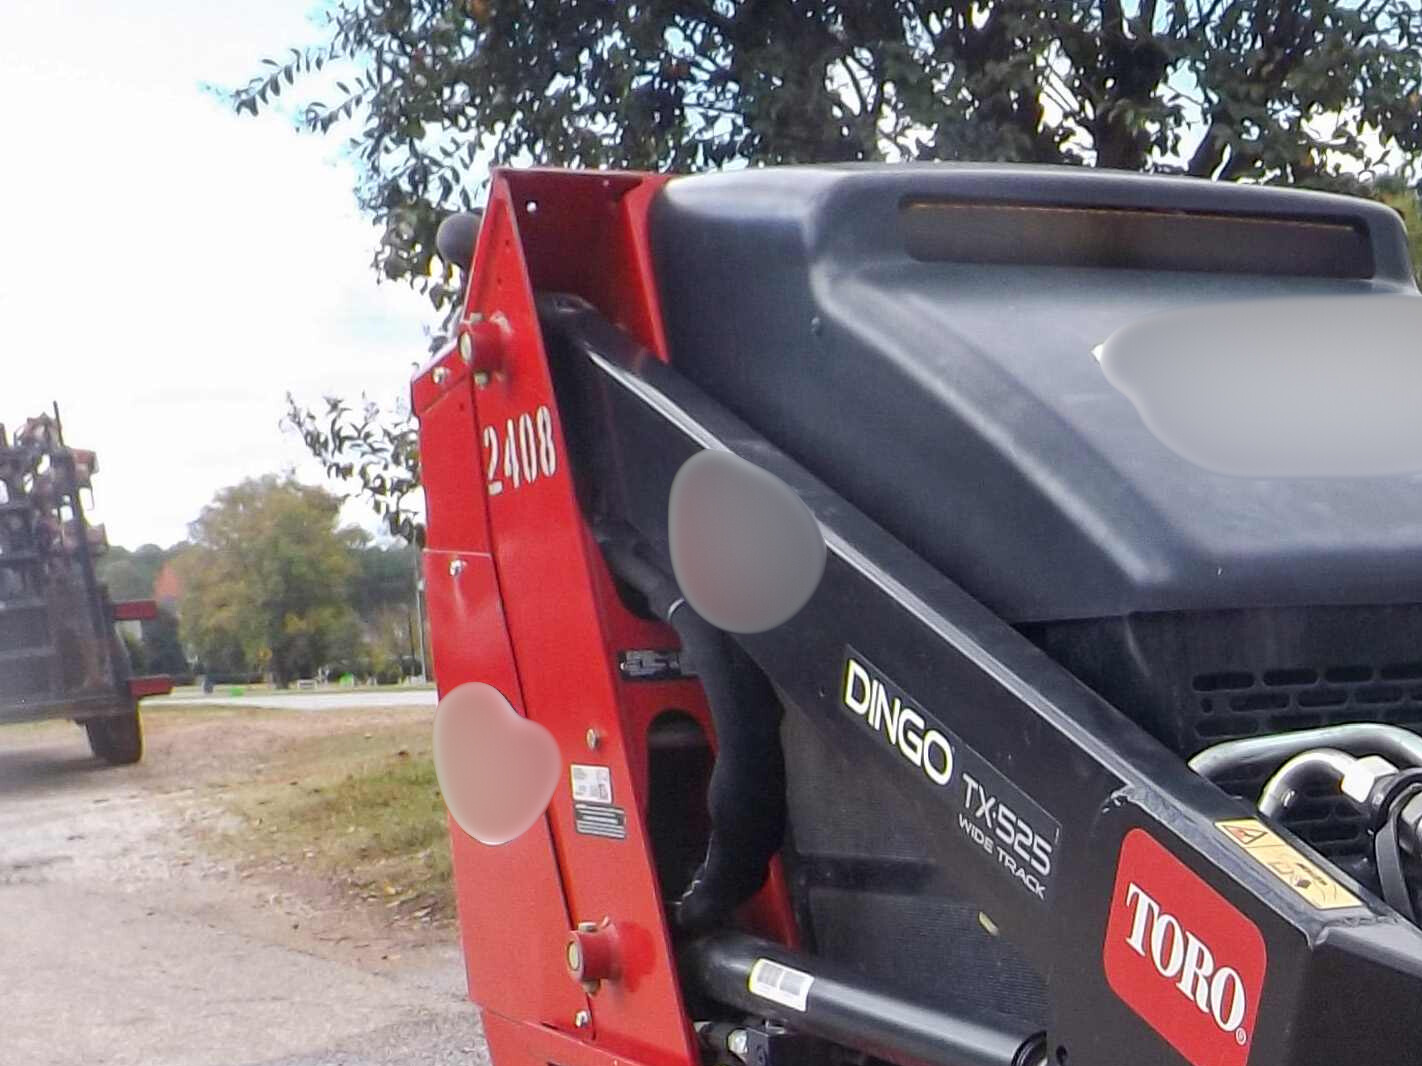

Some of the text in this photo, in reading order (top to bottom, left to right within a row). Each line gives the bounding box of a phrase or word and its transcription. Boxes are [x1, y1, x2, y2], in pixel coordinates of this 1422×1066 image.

[483, 405, 556, 496] 2408
[845, 659, 953, 786] DINGO
[958, 812, 1047, 900] WIDE TRACK
[1125, 882, 1246, 1032] TORO
